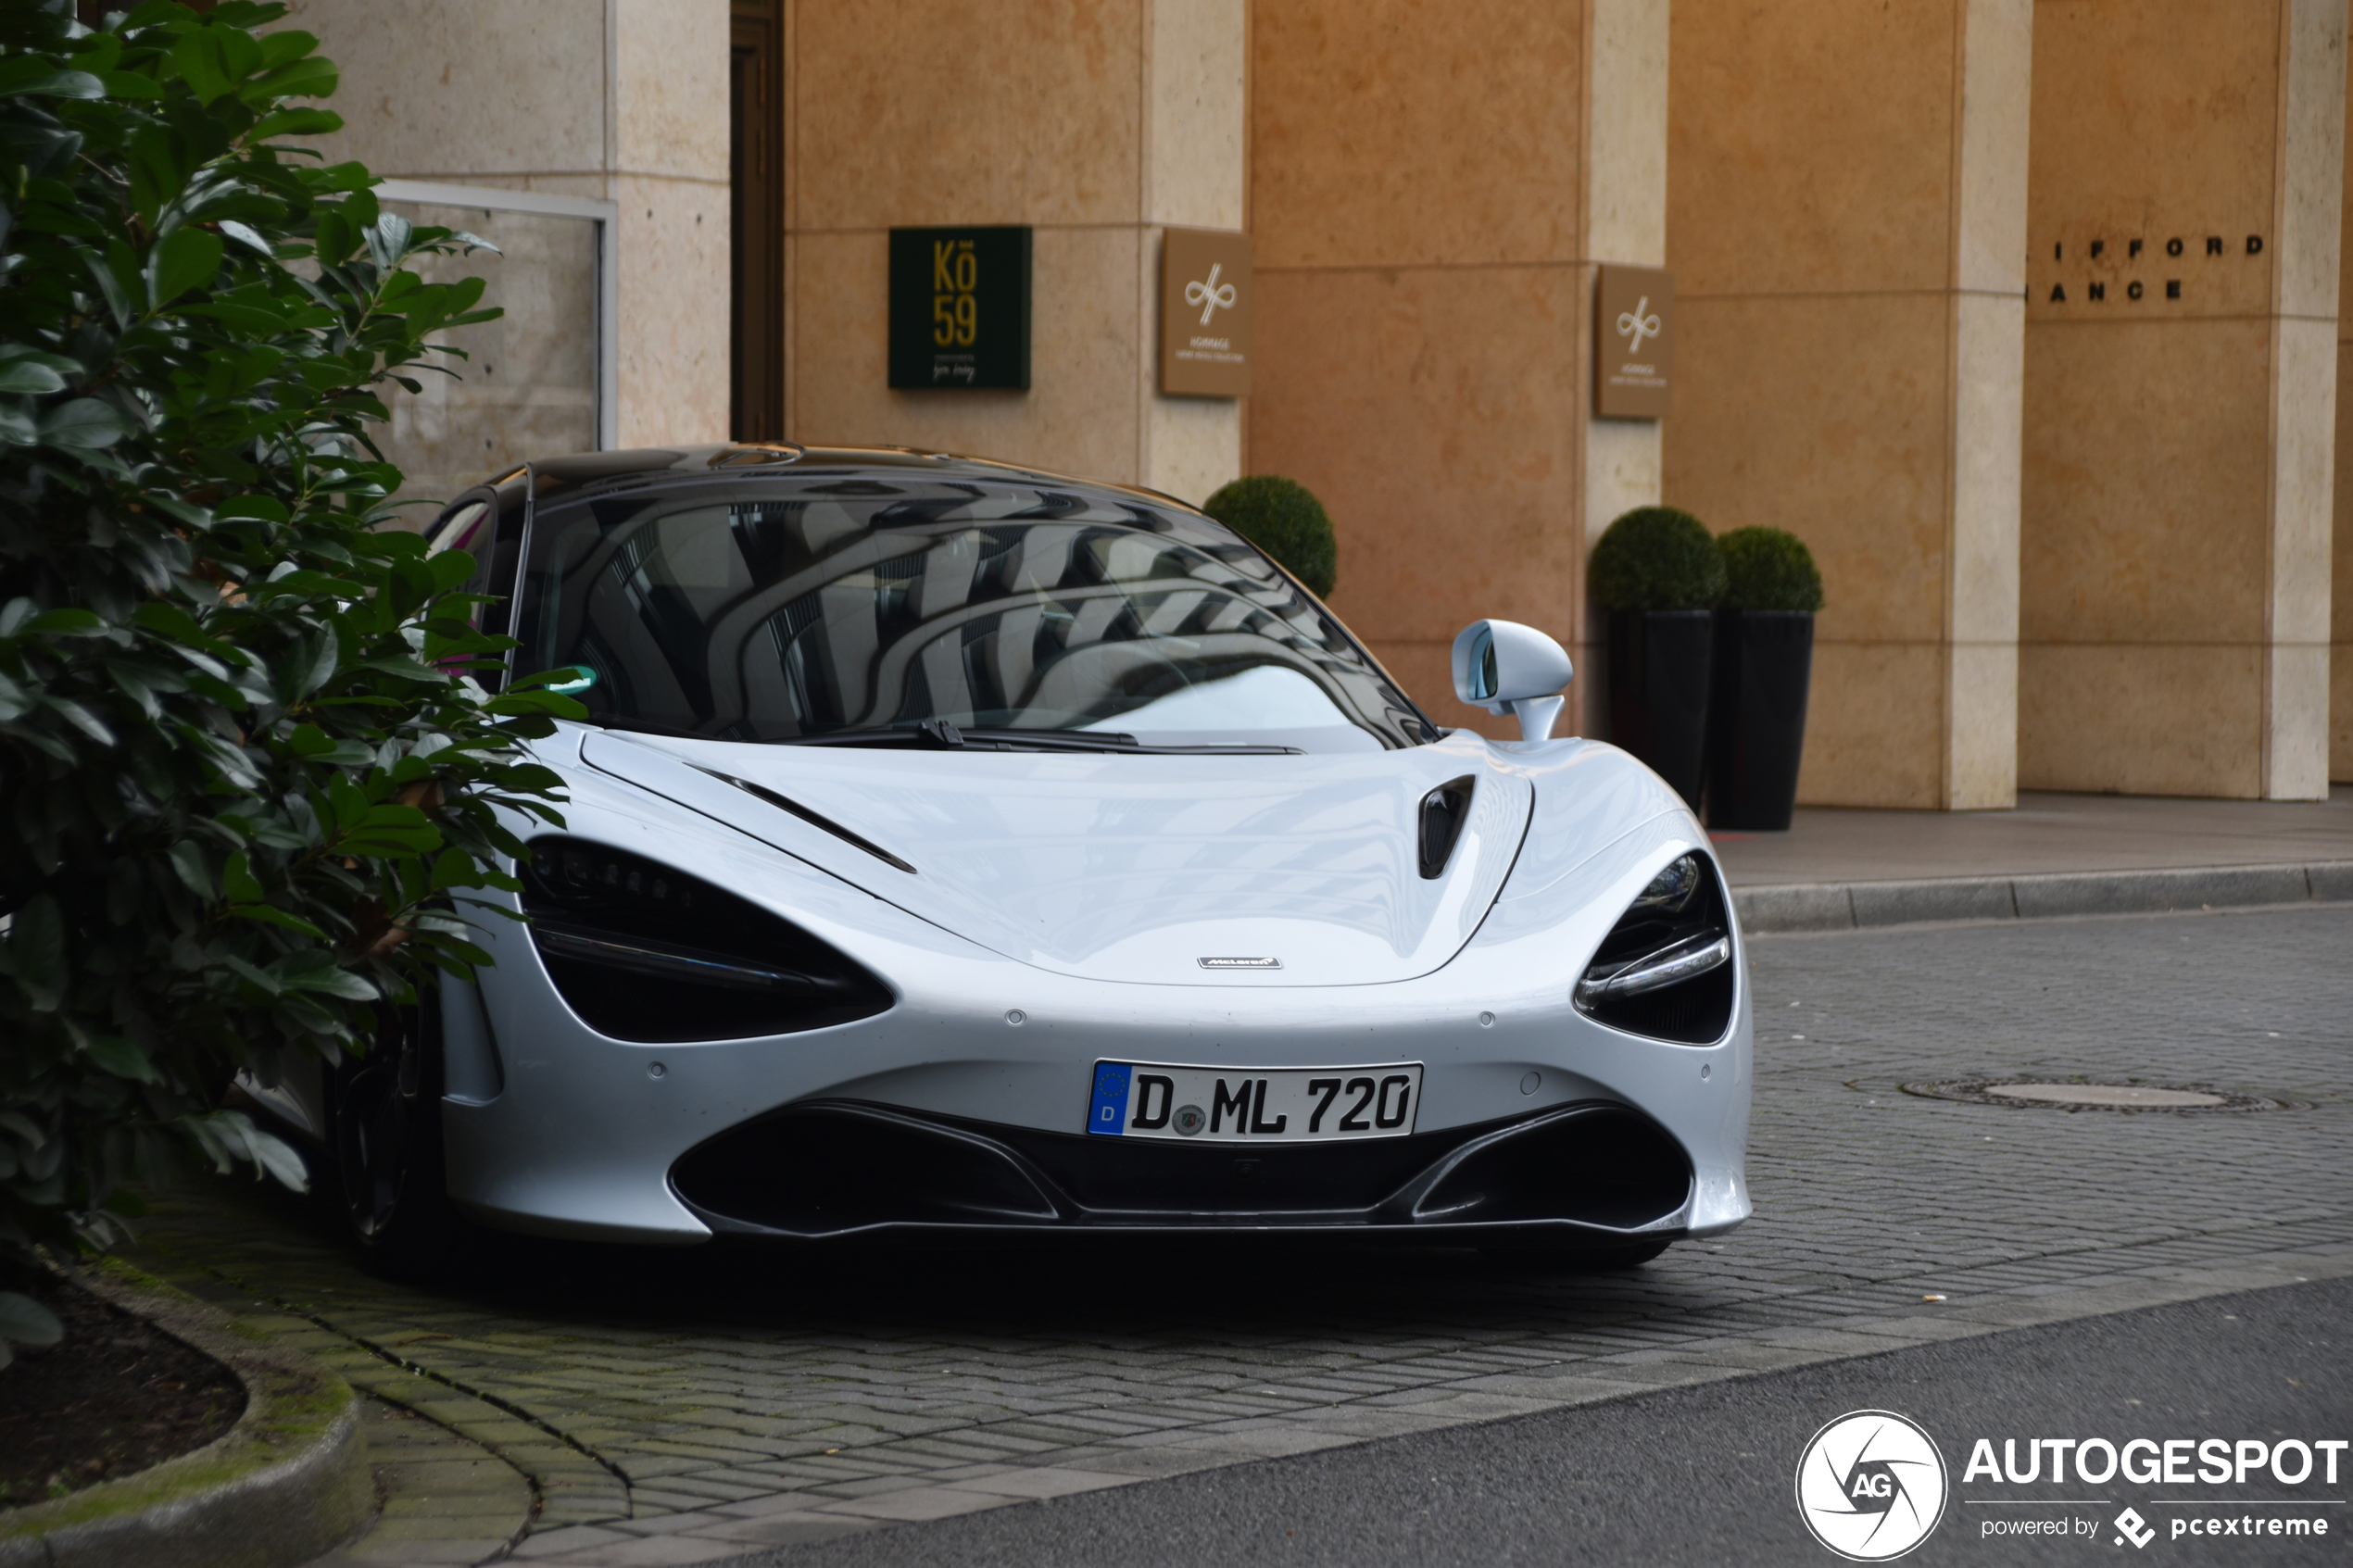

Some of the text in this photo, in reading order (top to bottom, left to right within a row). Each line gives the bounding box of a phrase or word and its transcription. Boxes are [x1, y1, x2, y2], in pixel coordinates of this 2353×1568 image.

[2026, 235, 2263, 263] IFFORD
[2022, 280, 2181, 303] ANCE
[934, 295, 976, 346] 59
[1101, 1106, 1114, 1122] D
[1132, 1074, 1175, 1129] D
[1210, 1078, 1288, 1134] ML
[1308, 1074, 1411, 1133] 720
